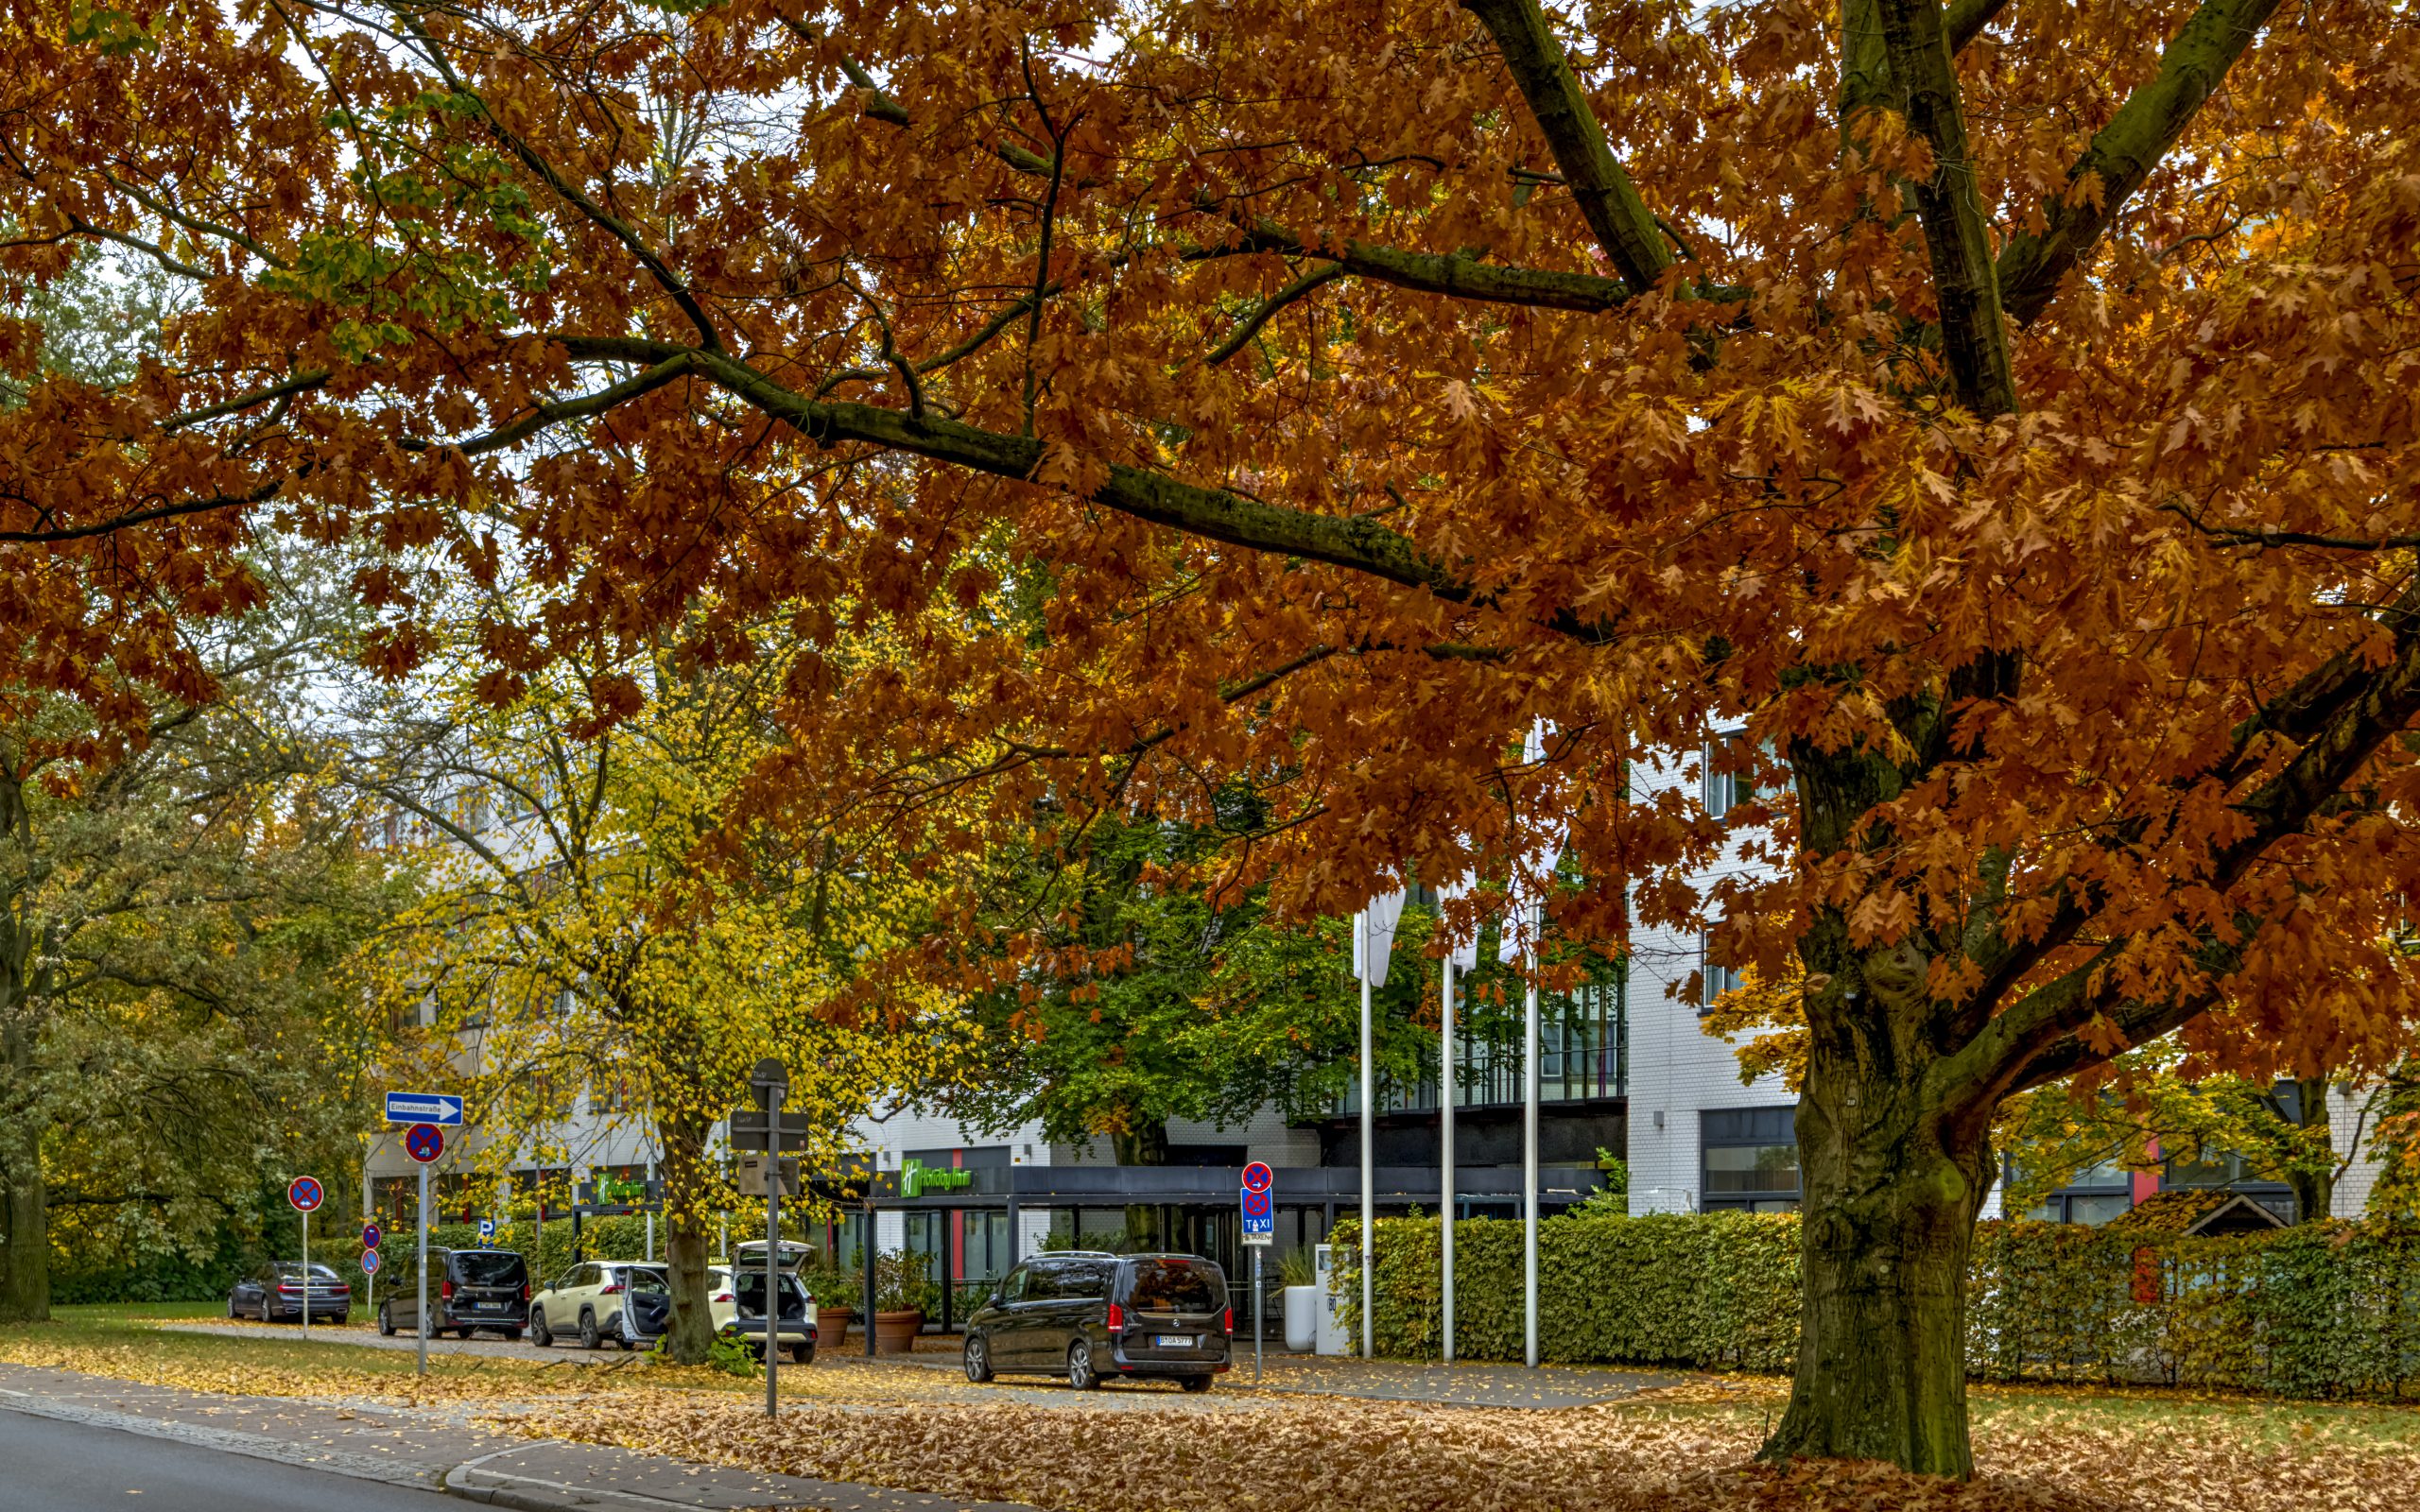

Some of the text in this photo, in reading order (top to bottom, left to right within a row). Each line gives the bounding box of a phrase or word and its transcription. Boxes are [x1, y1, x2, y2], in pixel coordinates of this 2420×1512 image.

[390, 1103, 441, 1113] Einbahnstraße
[920, 1168, 971, 1191] Holiday Inn
[1245, 1219, 1270, 1229] TAXI
